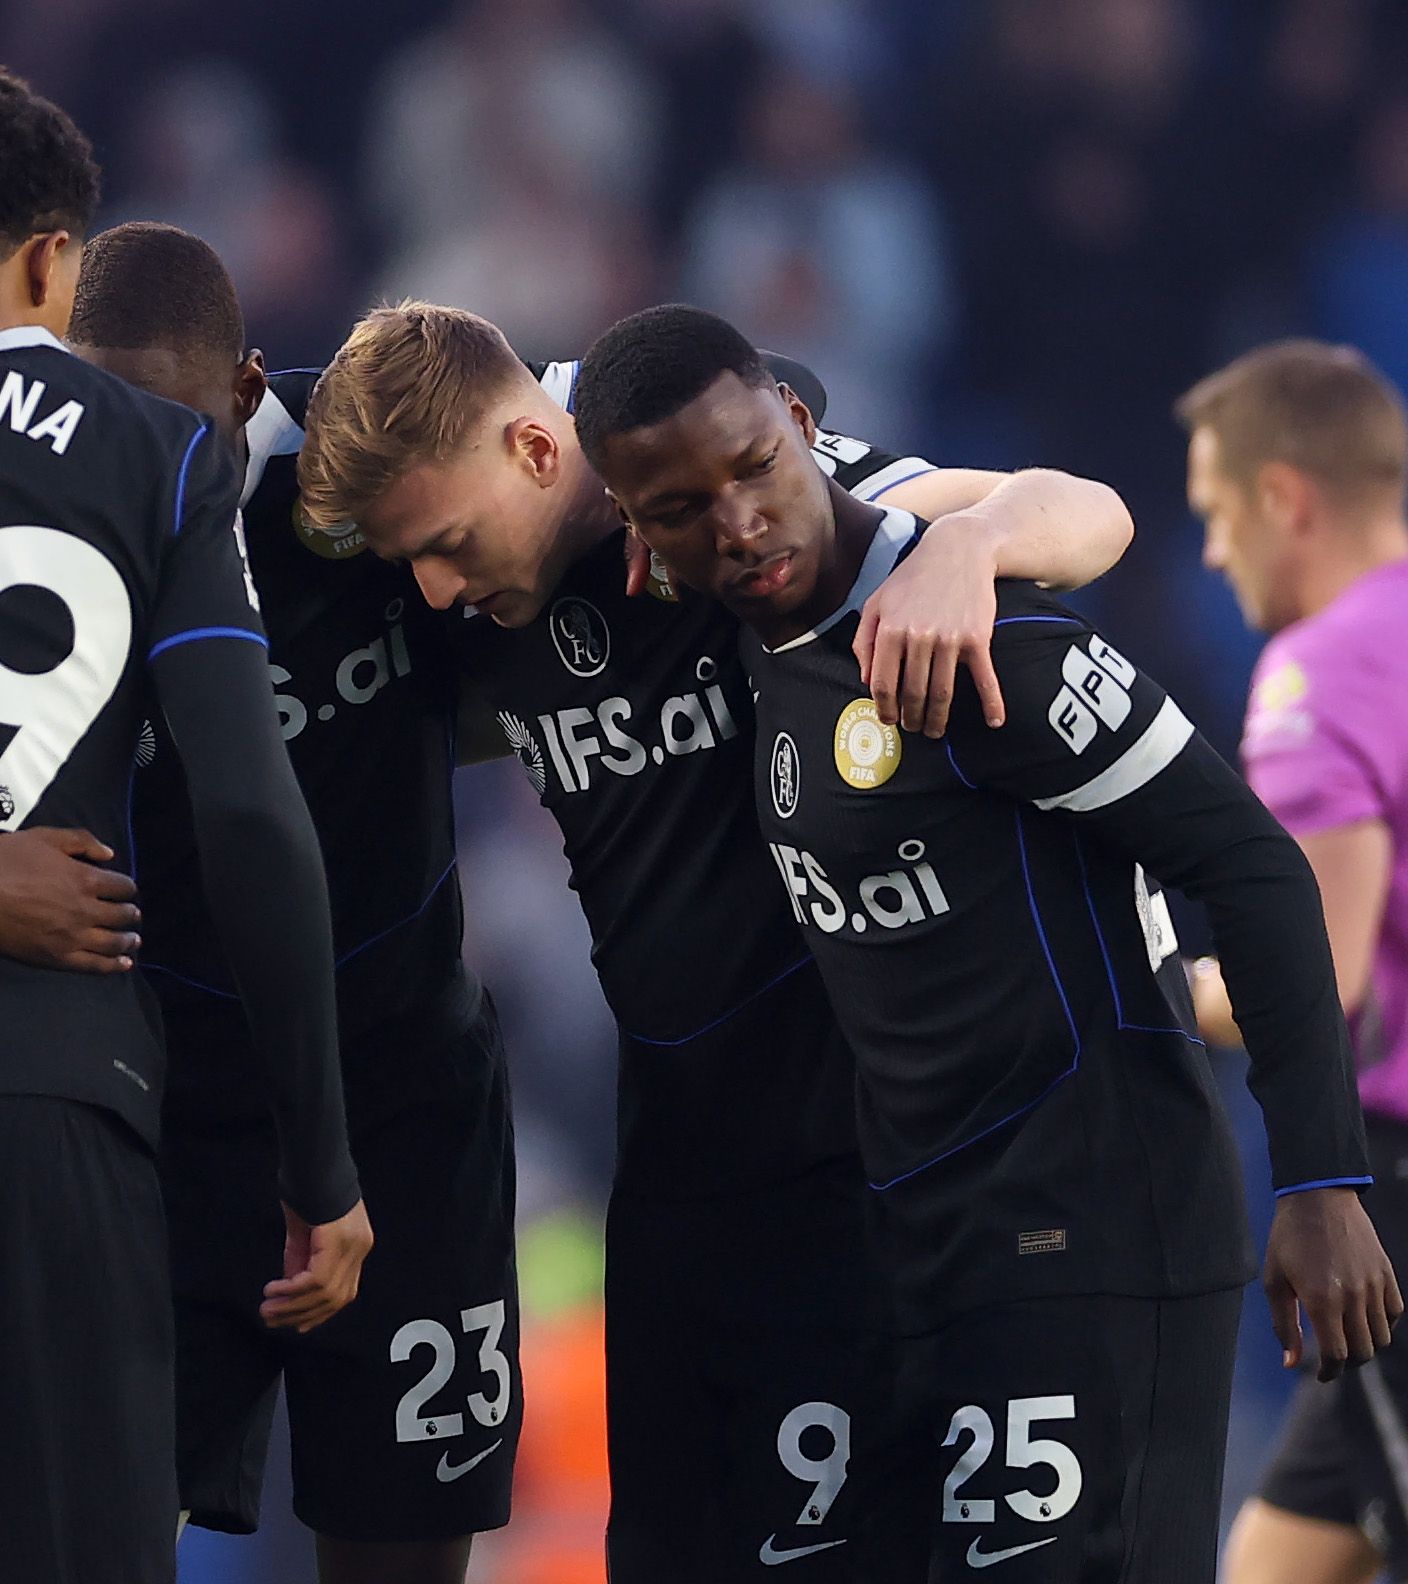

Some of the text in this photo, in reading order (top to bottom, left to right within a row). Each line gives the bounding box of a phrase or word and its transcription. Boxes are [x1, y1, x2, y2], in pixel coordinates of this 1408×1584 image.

[267, 597, 412, 741] S.ai
[537, 655, 739, 793] IFS.ai
[1052, 640, 1132, 750] FPT
[849, 766, 876, 782] FIFA
[857, 707, 895, 757] CHAIONS
[768, 838, 951, 934] IFS.ai
[389, 1299, 511, 1443] 23
[777, 1401, 851, 1525] 9
[939, 1394, 1083, 1523] 25
